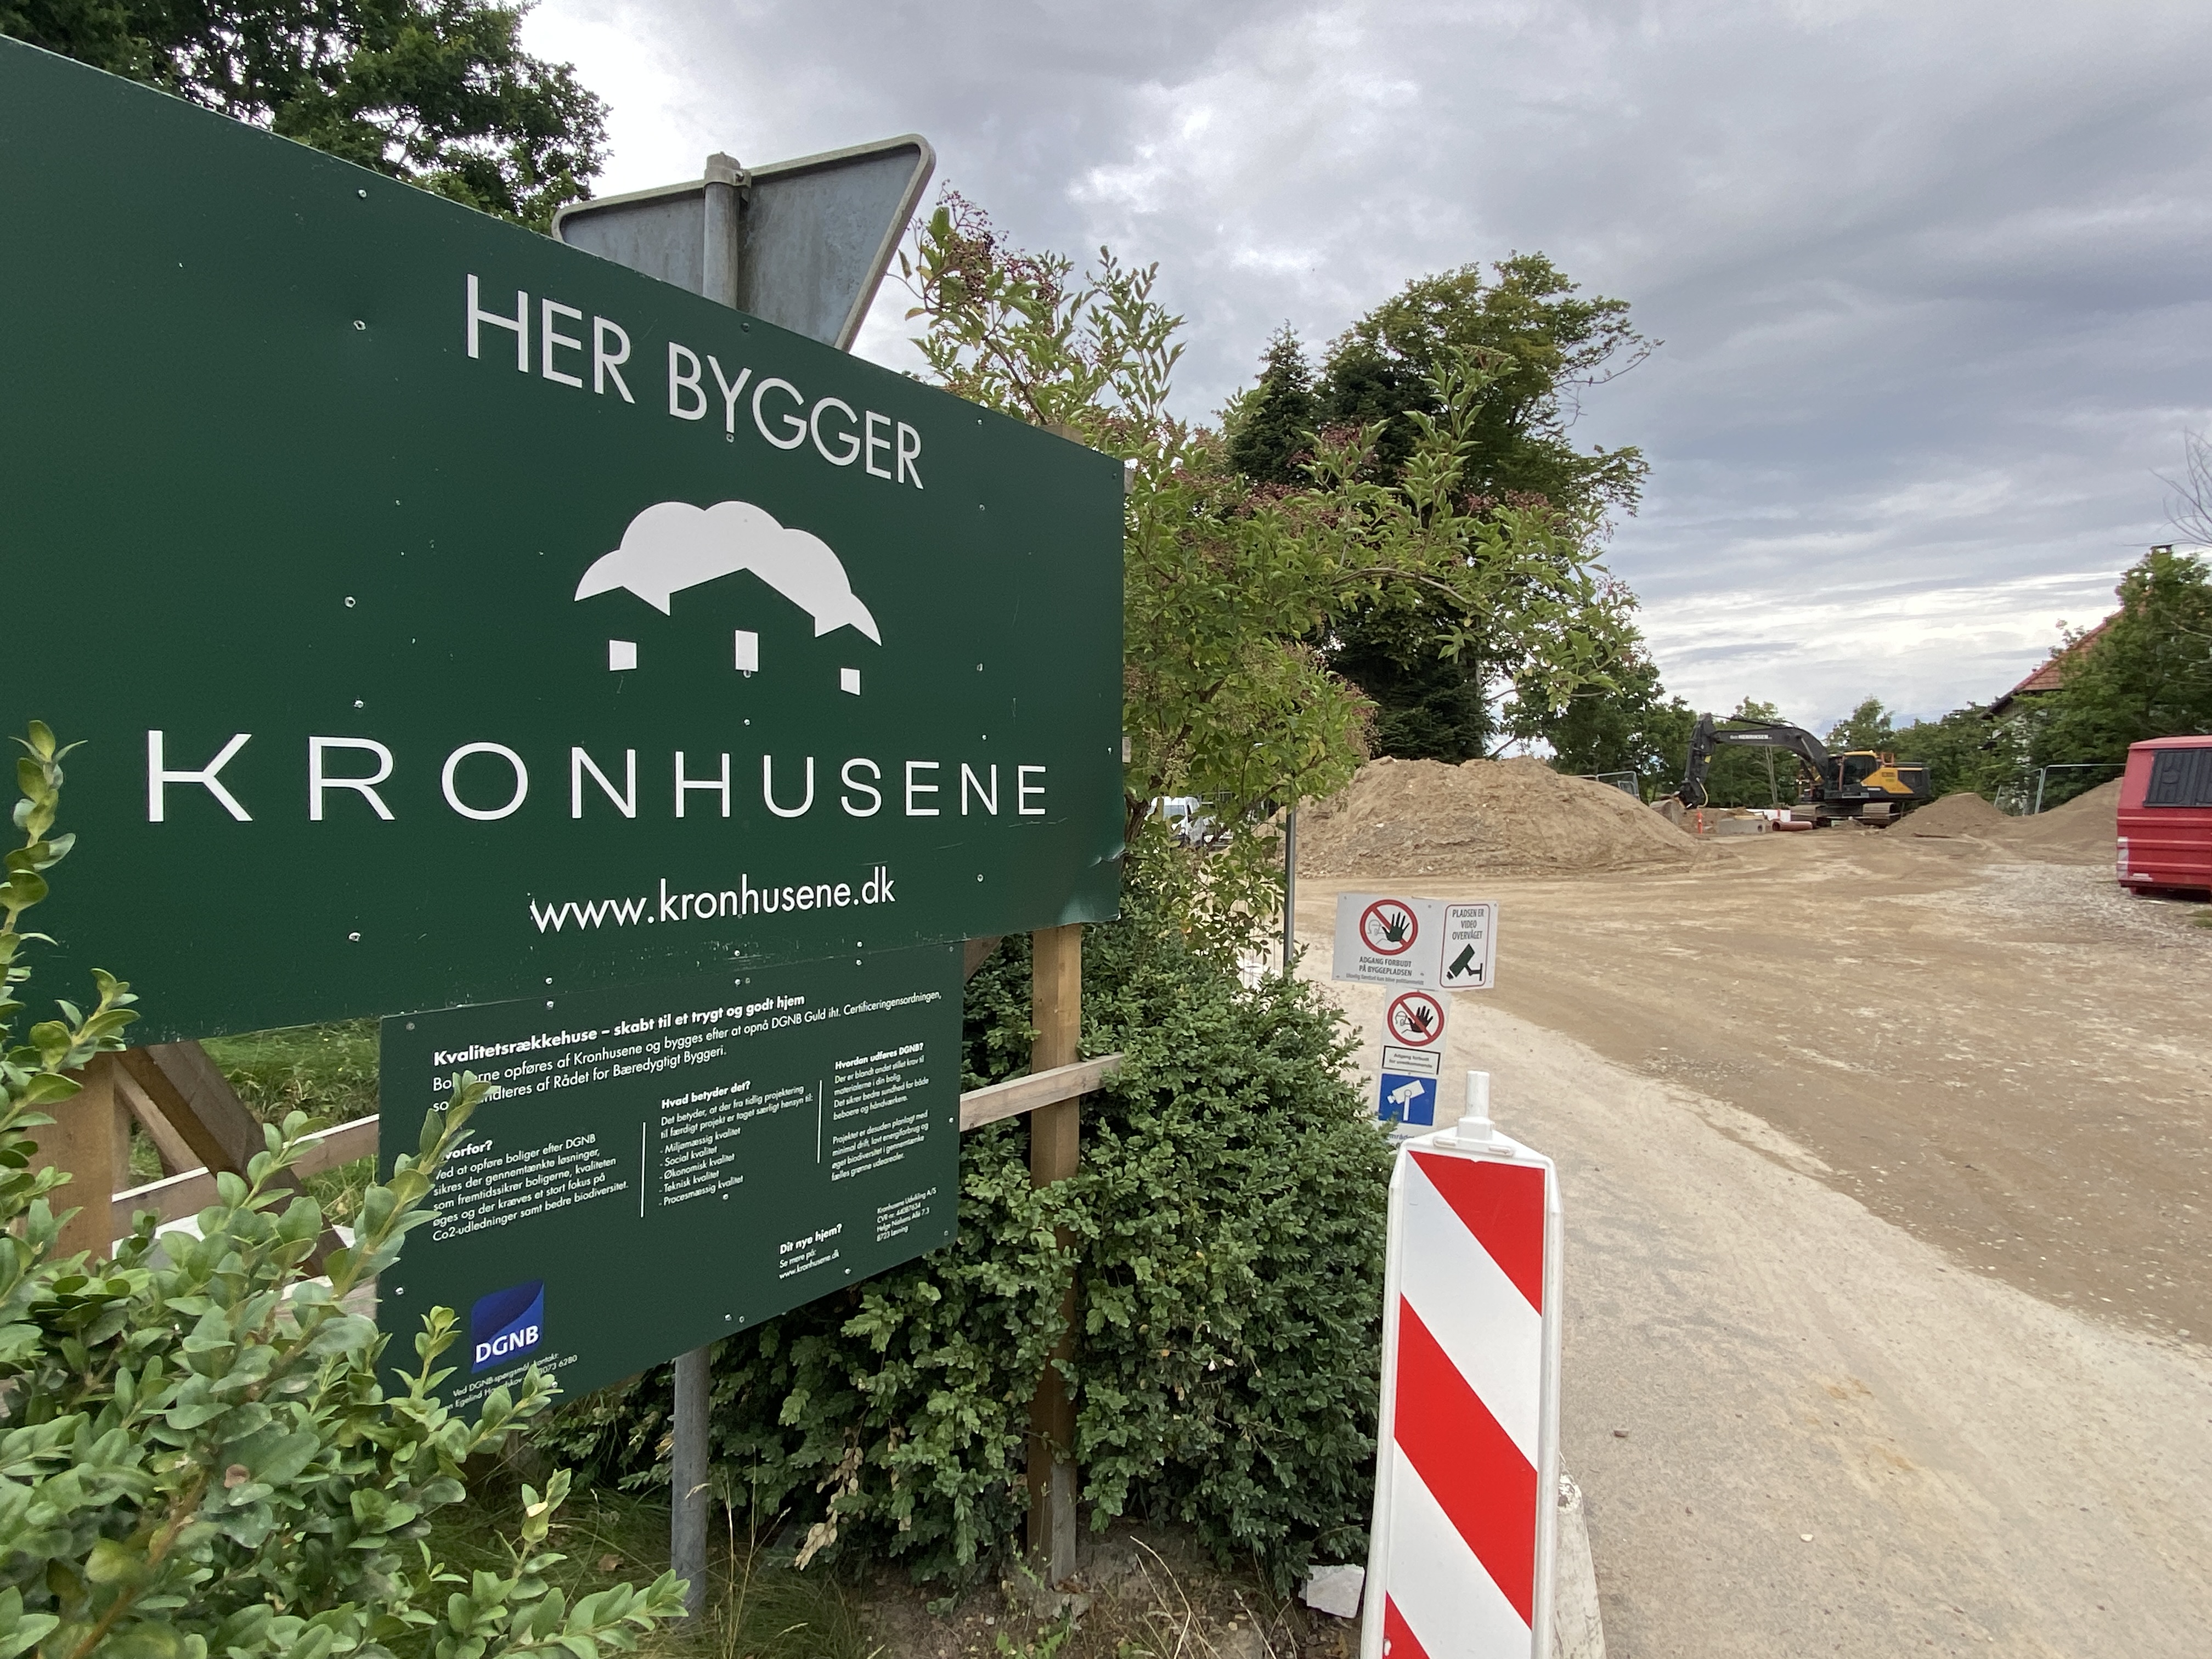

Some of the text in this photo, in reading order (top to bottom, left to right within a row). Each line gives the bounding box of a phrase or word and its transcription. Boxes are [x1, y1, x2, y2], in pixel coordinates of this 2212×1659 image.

[466, 273, 924, 490] HER BYGGER
[146, 729, 1047, 822] KRONHUSENE
[530, 866, 895, 934] www.kronhusene.dk
[1452, 909, 1485, 918] PLADSEN ER
[1452, 929, 1483, 940] OVERVÅGET
[1460, 919, 1477, 929] VIDEO
[1359, 956, 1412, 968] ADGANG FORBUDT
[1359, 964, 1412, 977] PÅ BYGGEPLADSEN
[433, 995, 805, 1066] Kvalitetsrækkehuse skabt til et trygt og godt hjem
[504, 991, 942, 1080] opføres af Kronhusene og bygges efter at opnå DGNB Guld iht. Certificeringensordningen,
[537, 1045, 727, 1092] af Rådet for Bæredygtigt Byggeri.
[835, 1042, 924, 1070] Hvordan udføres DGNB?
[834, 1075, 846, 1084] Der
[855, 1067, 874, 1079] blandt
[875, 1063, 891, 1074] andet
[907, 1058, 918, 1066] krav
[661, 1080, 751, 1109] Hvad betyder det?
[834, 1081, 872, 1096] materialerne
[876, 1076, 885, 1086] din
[834, 1099, 845, 1108] Det
[846, 1095, 862, 1105] sikrer
[863, 1090, 880, 1101] bedre
[881, 1081, 905, 1096] sundhed
[915, 1076, 929, 1087] både
[661, 1085, 804, 1126] Det betyder, at der fra tidlig projektering
[670, 1123, 698, 1137] færdigt
[700, 1116, 726, 1131] projekt
[727, 1114, 735, 1123] er
[736, 1109, 755, 1121] taget
[756, 1103, 779, 1115] særligt
[781, 1098, 804, 1110] hensyn
[833, 1107, 859, 1121] beboere
[860, 1105, 869, 1114] og
[445, 1139, 493, 1160] vorfor?
[457, 1165, 467, 1175] at
[470, 1157, 503, 1174] opføre
[506, 1150, 540, 1164] boliger
[543, 1143, 563, 1155] efter
[566, 1133, 596, 1149] DGNB
[664, 1127, 741, 1154] Miljømæssig kvalitet
[664, 1146, 718, 1167] Social kvalitet
[664, 1153, 735, 1180] Økonomisk kvalitet
[433, 1148, 600, 1197] sikres der gennemtænkte løsninger,
[433, 1157, 616, 1211] som fremtidssikrer boligerne, kvaliteten
[664, 1170, 720, 1193] Teknisk kvalitet
[432, 1172, 606, 1228] øges og der kræves et stort fokus på
[663, 1175, 743, 1206] Procesmæssig kvalitet
[927, 1187, 936, 1196] A/S
[432, 1180, 629, 1242] Co2-udledninger samt bedre biodiversitet.
[780, 1223, 843, 1255] Dit nye hjem?
[779, 1259, 788, 1268] Se
[789, 1254, 805, 1265] mere
[779, 1249, 840, 1279] www.kronhusene.dk
[476, 1325, 539, 1363] DGNB
[558, 1355, 578, 1367] 6280
[453, 1385, 467, 1397] Ved
[469, 1376, 493, 1392] DGNB
